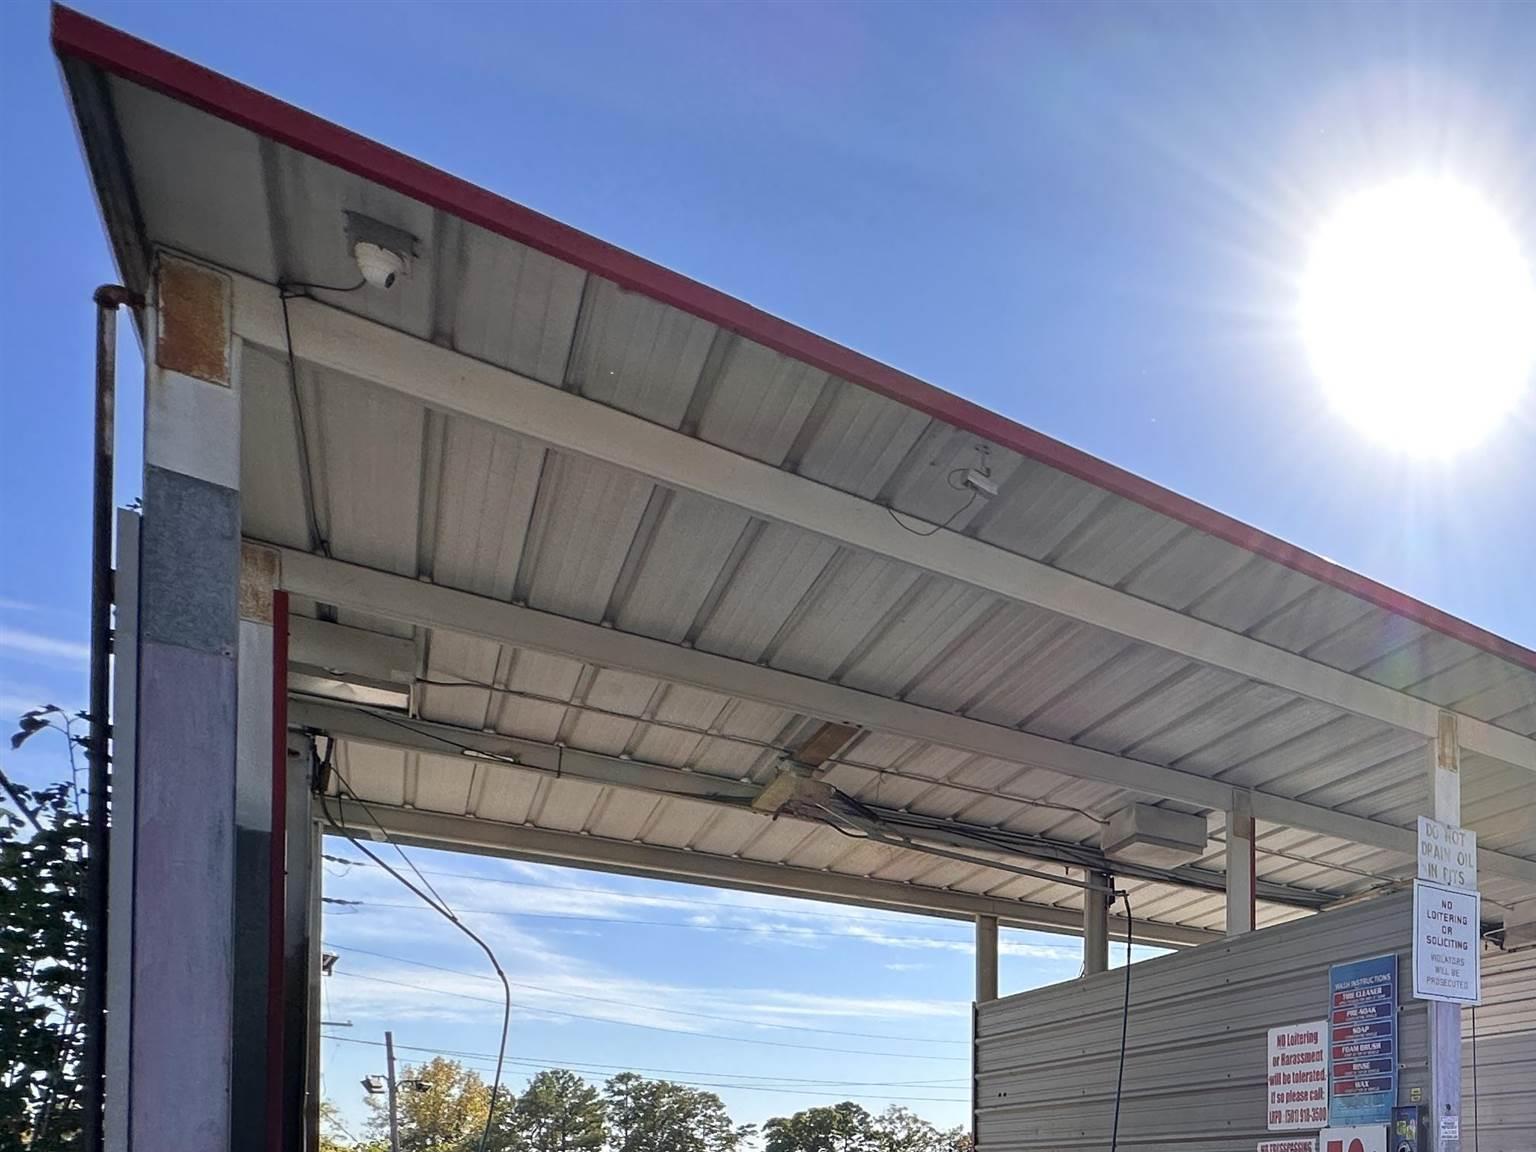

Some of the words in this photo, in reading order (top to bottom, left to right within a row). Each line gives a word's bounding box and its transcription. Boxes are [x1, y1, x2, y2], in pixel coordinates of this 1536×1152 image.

[1425, 822, 1440, 838] DO
[1444, 827, 1466, 847] NOT
[1456, 851, 1474, 869] OIL
[1426, 863, 1439, 879] IN
[1441, 899, 1454, 911] NO
[1426, 910, 1468, 926] LOITERING
[1441, 925, 1454, 936] OR
[1426, 935, 1469, 951] SOLICITING
[1430, 953, 1466, 967] VIOLATORS
[1434, 965, 1449, 977] WILL
[1451, 968, 1461, 978] BE
[1350, 972, 1392, 987] INSTRUCTIONS
[1426, 975, 1469, 990] PROSECUTED
[1355, 986, 1383, 999] CLEANER
[1352, 1025, 1370, 1035] SOAP
[1276, 1033, 1287, 1048] NO
[1286, 1030, 1319, 1047] Loitering
[1341, 1043, 1360, 1054] FOAM
[1359, 1041, 1382, 1053] BRUSH
[1272, 1055, 1281, 1067] or
[1280, 1049, 1324, 1067] Harassment
[1269, 1072, 1282, 1087] will
[1282, 1071, 1292, 1086] be
[1354, 1080, 1370, 1089] WAX
[1276, 1091, 1286, 1104] so
[1285, 1088, 1309, 1105] please
